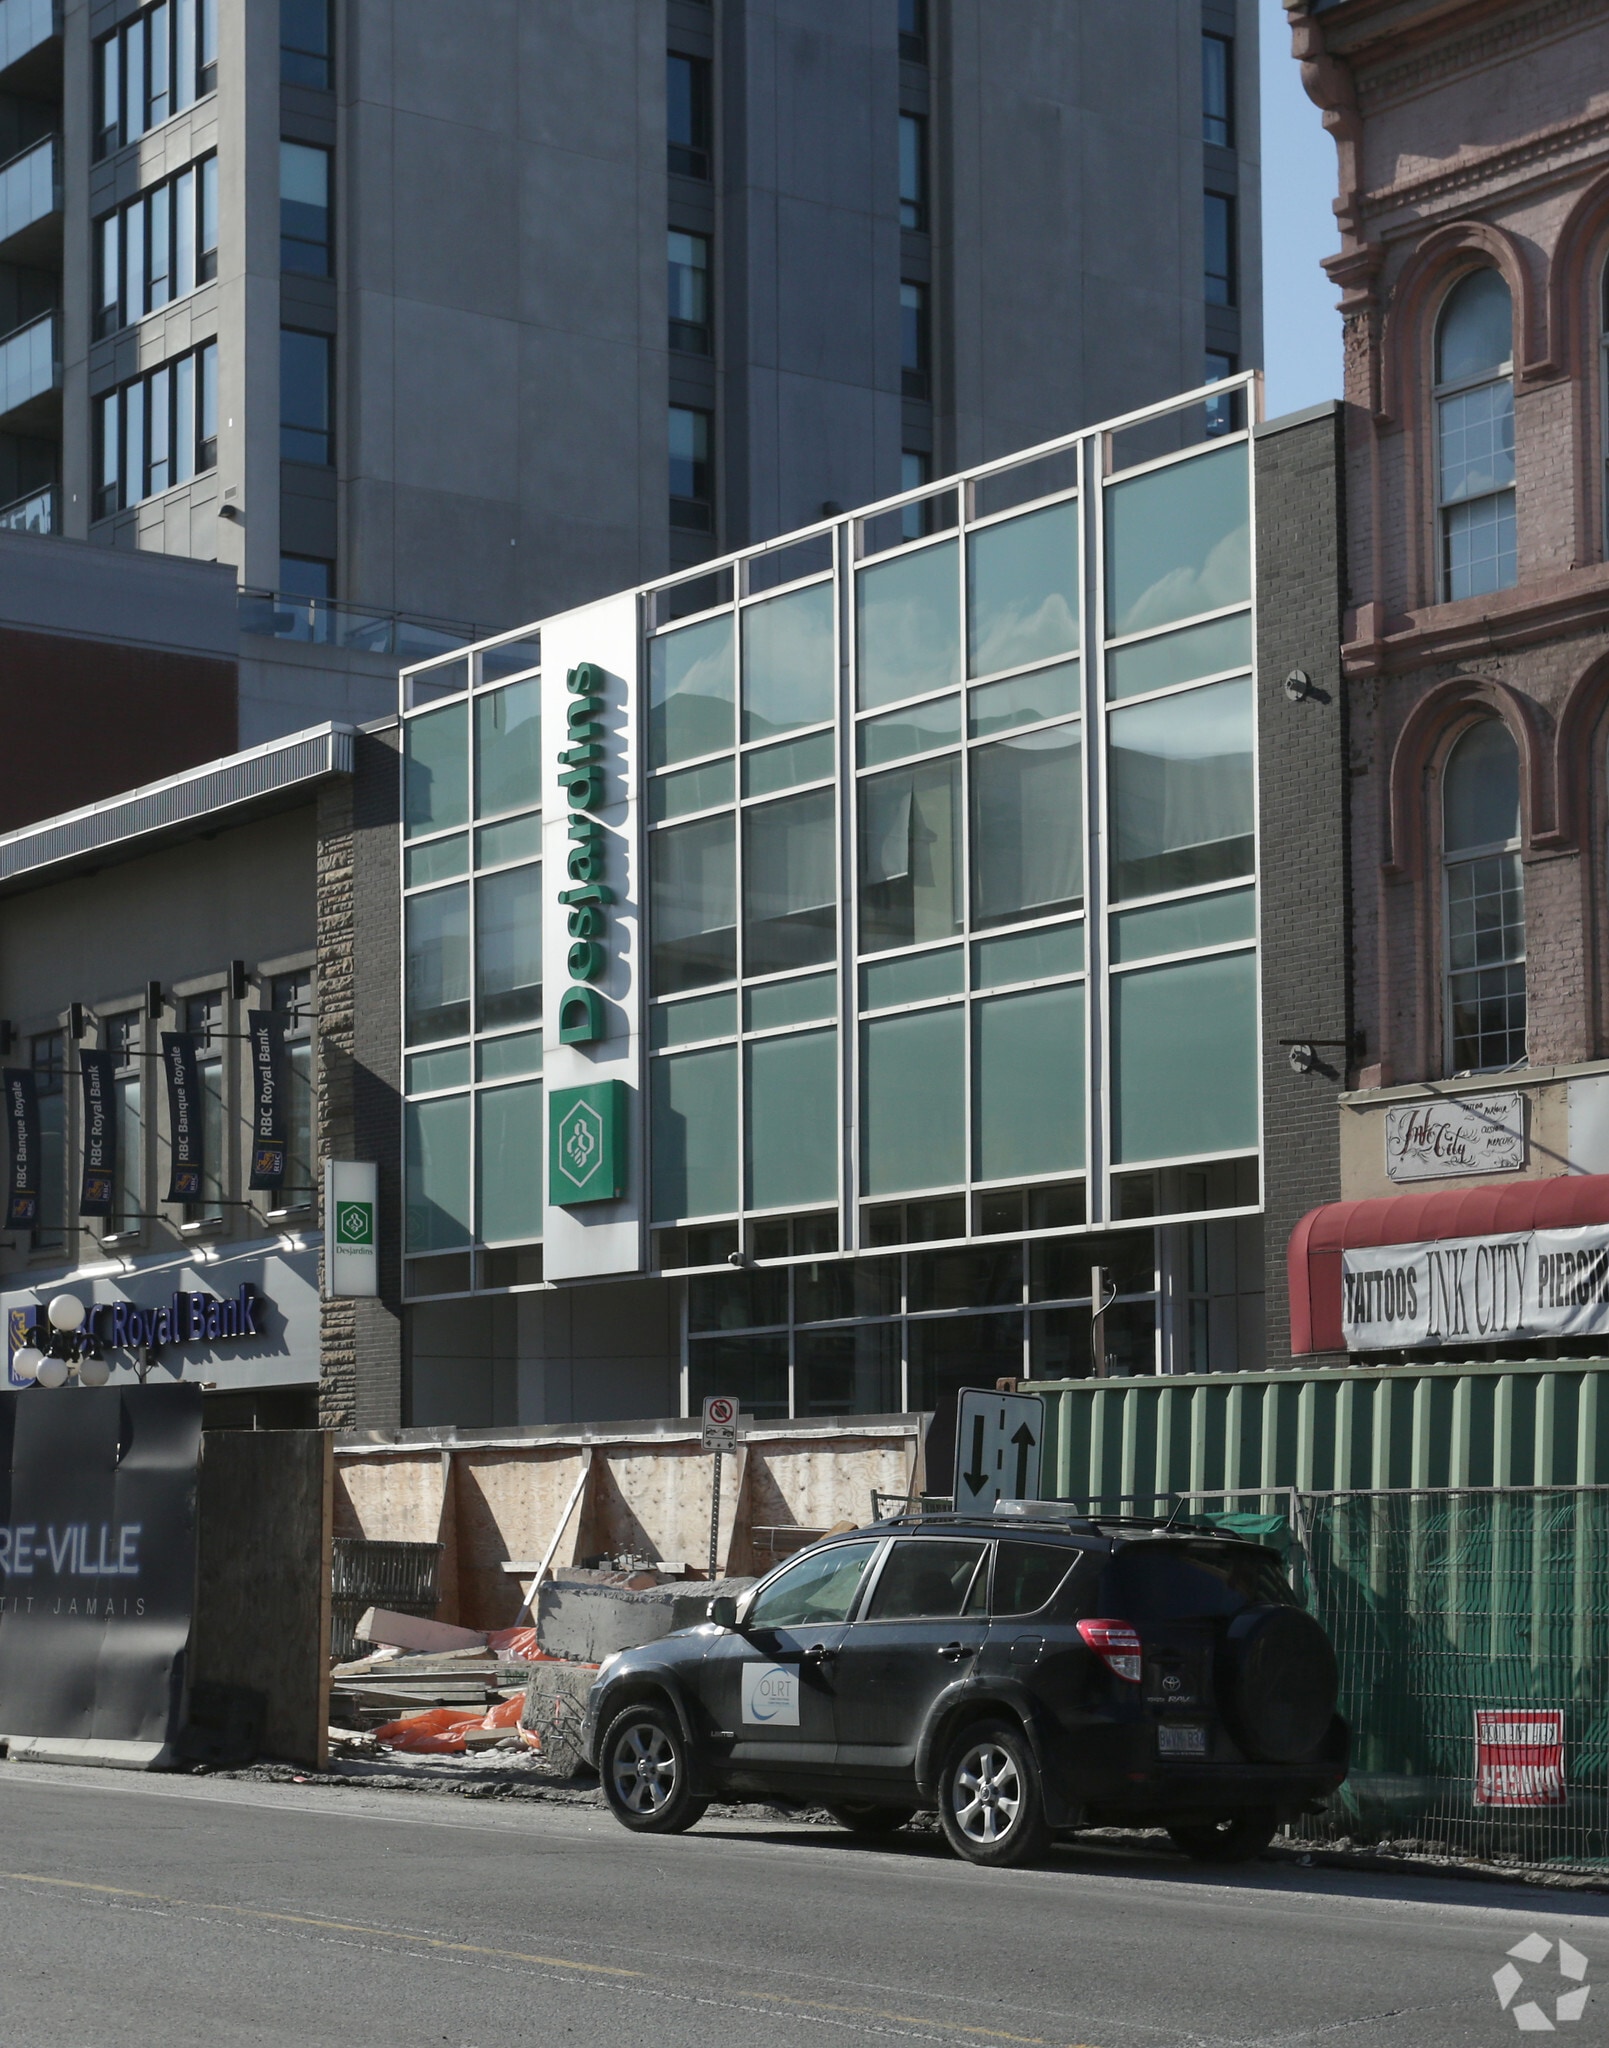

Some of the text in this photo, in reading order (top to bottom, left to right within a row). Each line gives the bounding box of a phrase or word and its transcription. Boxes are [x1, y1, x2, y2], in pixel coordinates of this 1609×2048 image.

[557, 661, 614, 1044] Desjardins
[88, 1065, 104, 1166] RBC Royal Bank
[171, 1046, 188, 1161] RBC Banque Royale
[256, 1028, 275, 1137] RBC Royal Bank
[12, 1081, 28, 1188] RBC Banque Royale
[273, 1155, 281, 1172] RBC
[1390, 1108, 1466, 1162] Ink City
[336, 1246, 373, 1256] Desjardins
[112, 1292, 181, 1349] Royal
[188, 1282, 257, 1340] Bank
[1345, 1266, 1417, 1323] TATTOOS
[1426, 1249, 1469, 1337] INK
[1475, 1242, 1529, 1335] CITY
[53, 1598, 145, 1616] JAMAIS
[760, 1680, 791, 1697] OLRT
[1482, 1766, 1560, 1797] DANGER
